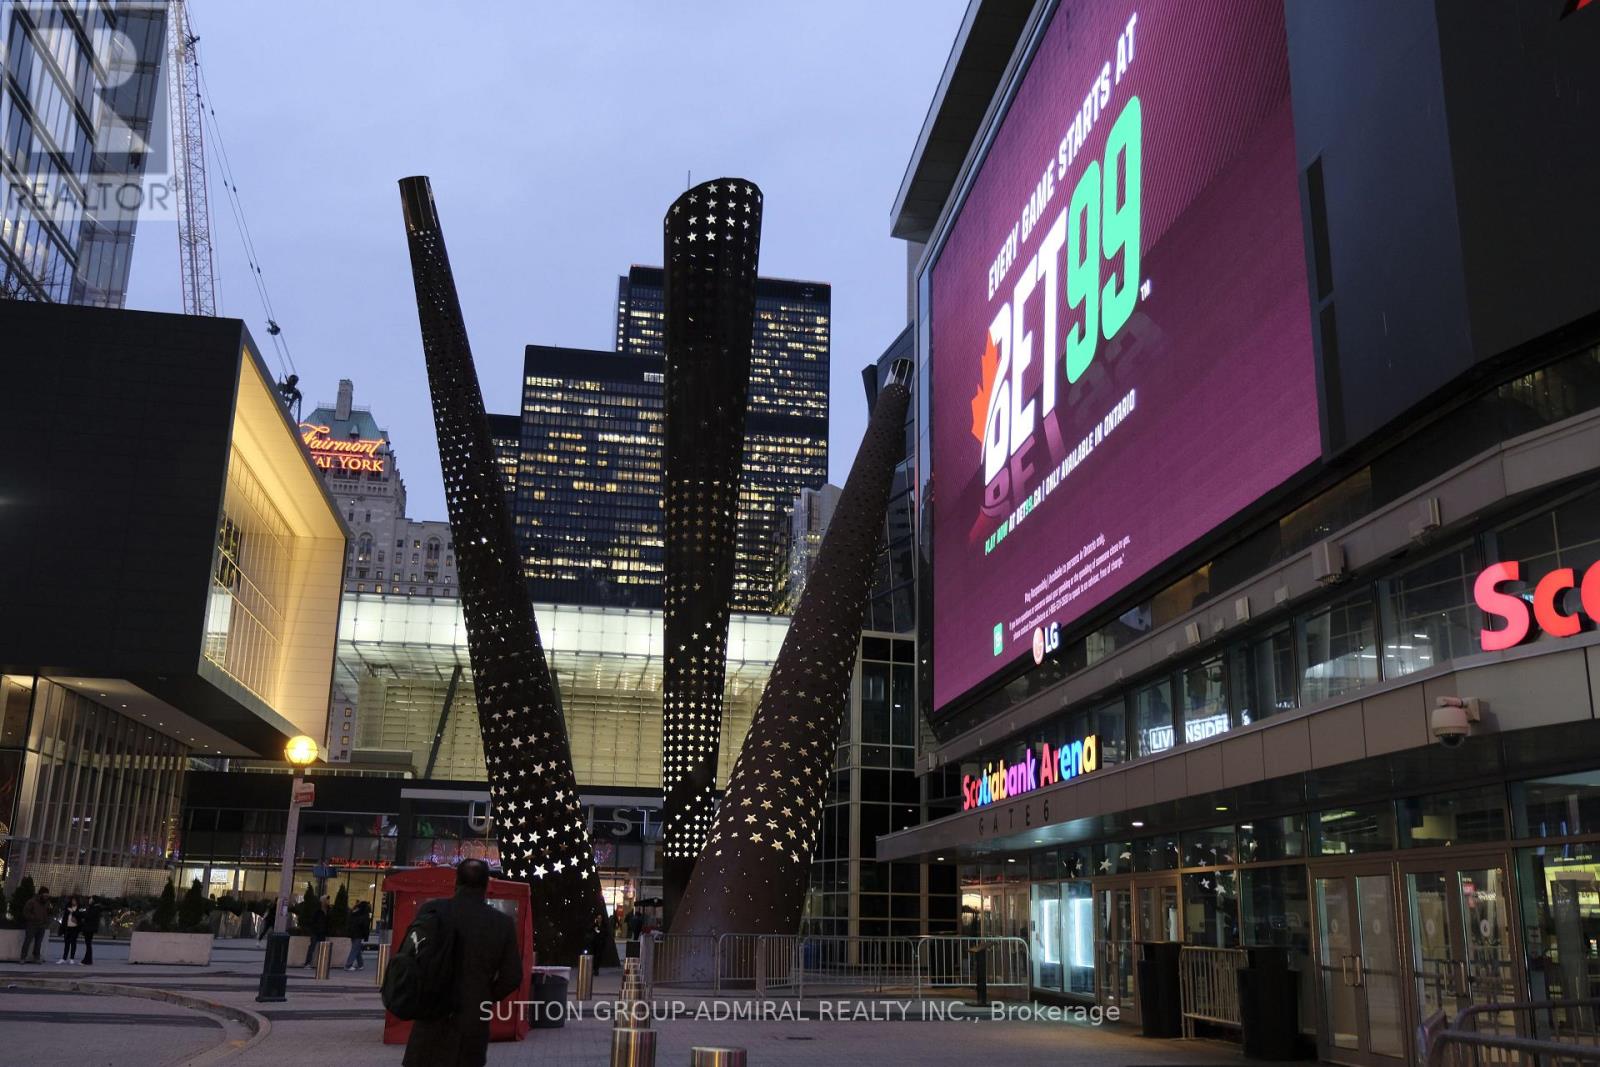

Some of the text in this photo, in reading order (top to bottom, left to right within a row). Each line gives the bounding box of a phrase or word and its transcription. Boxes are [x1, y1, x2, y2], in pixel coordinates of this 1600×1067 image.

[988, 11, 1137, 302] EVERY GAME STARTS AT
[981, 95, 1142, 487] BET99
[299, 423, 387, 458] Fairmont
[1061, 431, 1094, 480] AVAILABLE
[1095, 422, 1103, 447] IN
[1104, 388, 1135, 437] ONTARIO
[339, 456, 384, 472] YORK
[1044, 621, 1060, 654] LG
[963, 734, 1097, 811] Scotiabank Arena
[978, 799, 1051, 836] GATE 6
